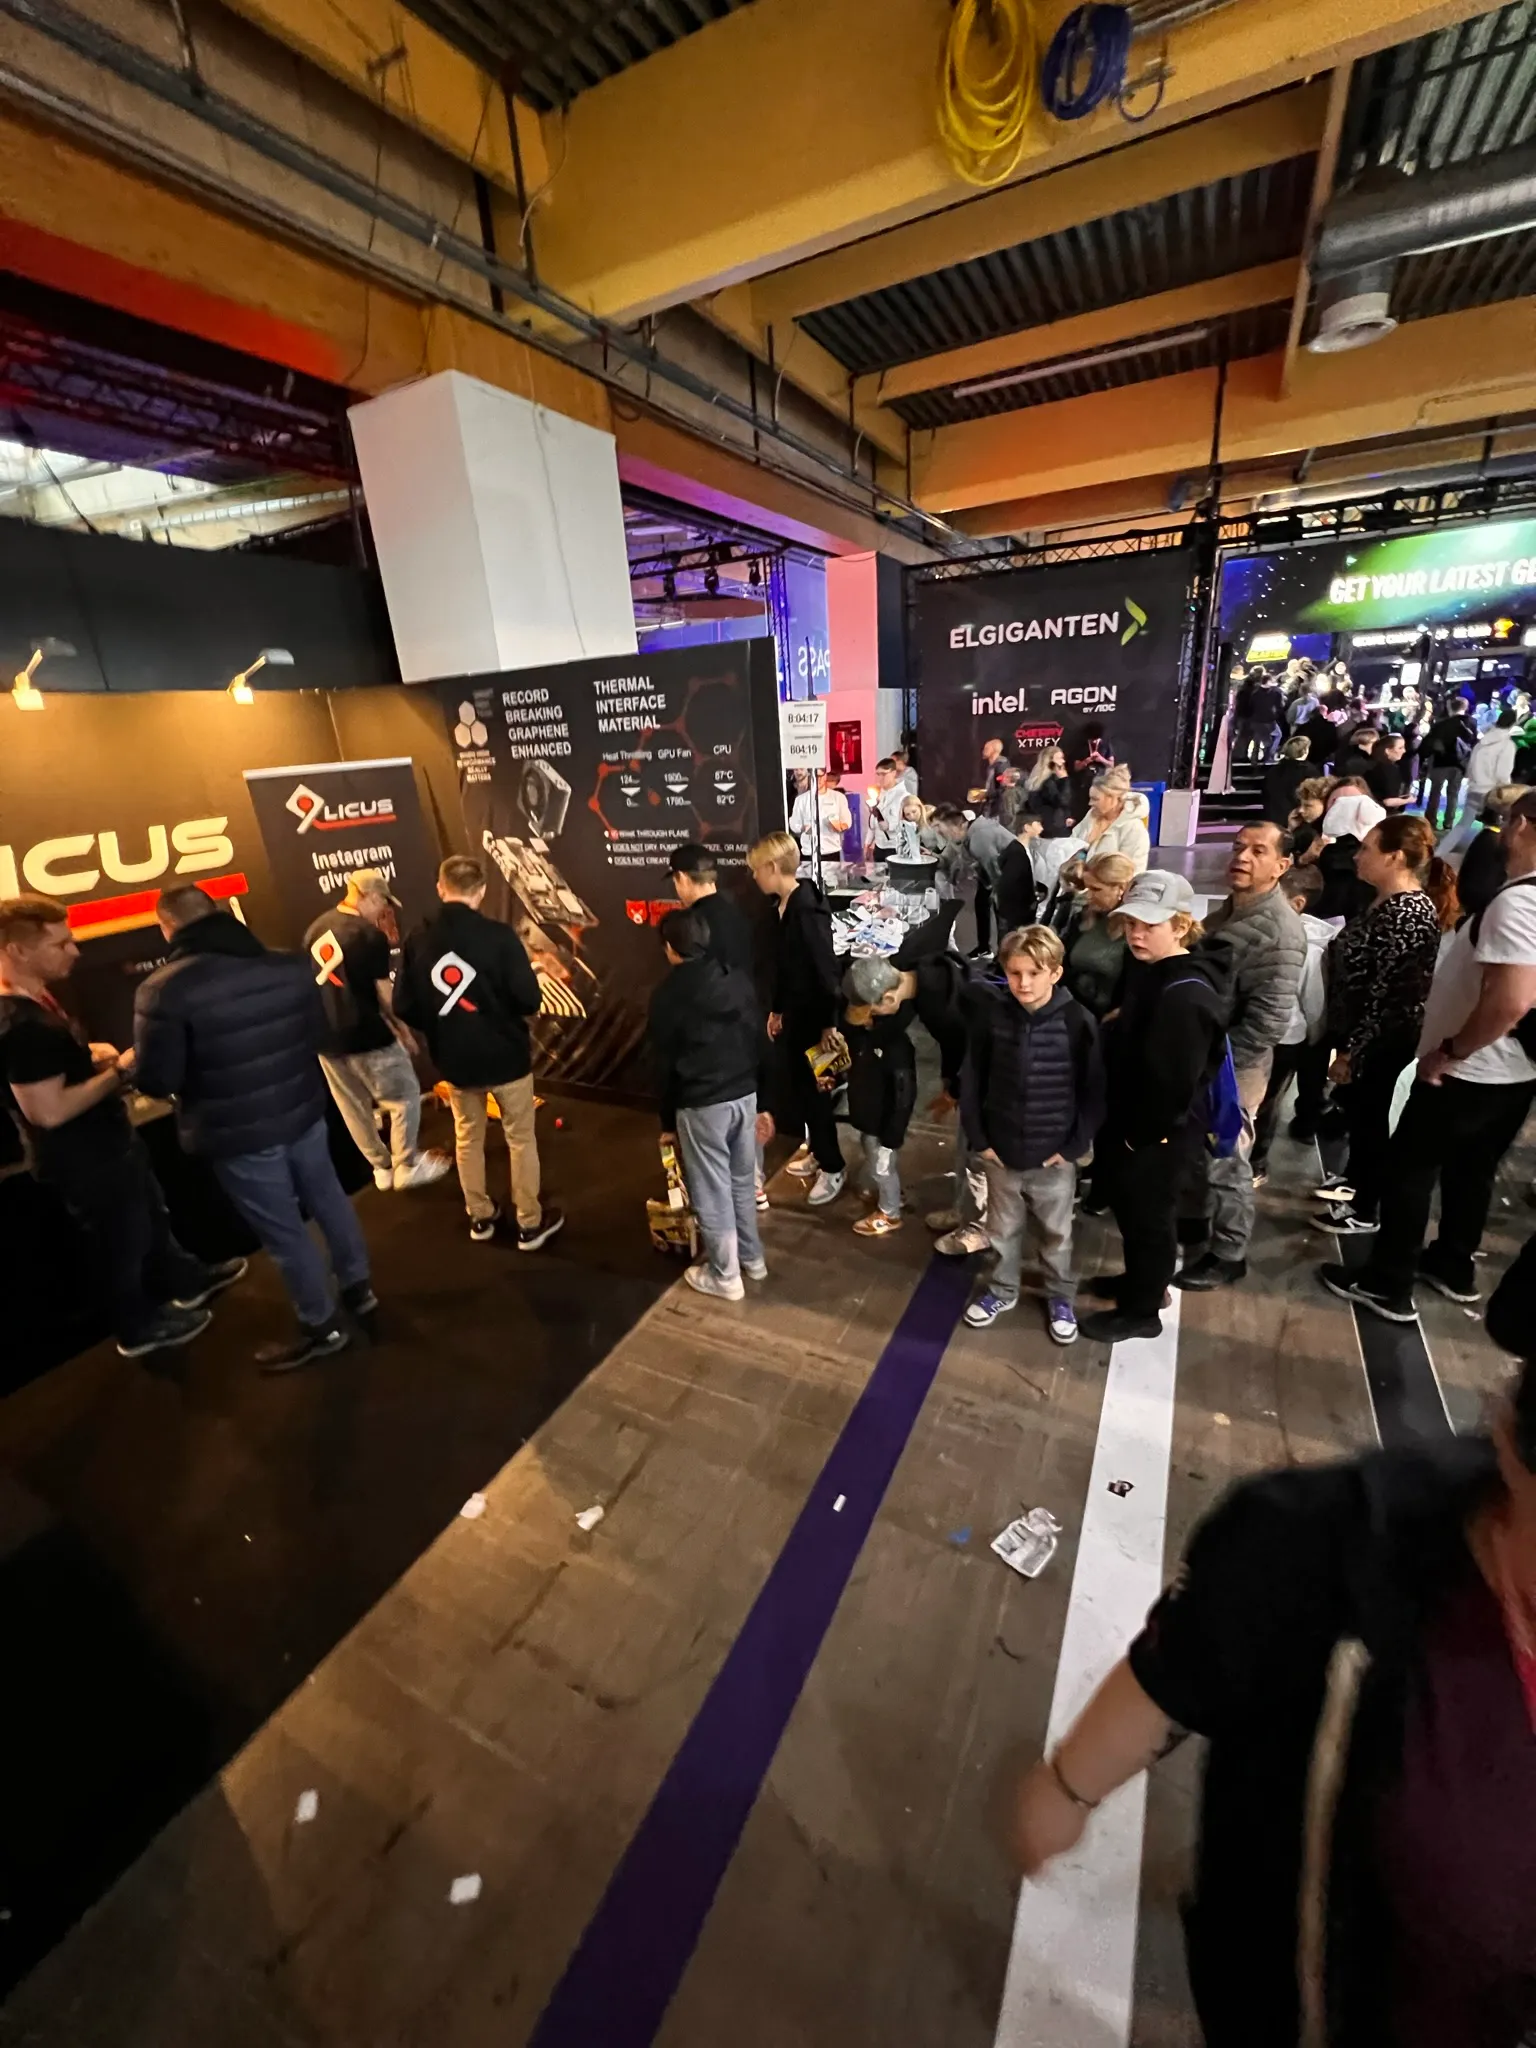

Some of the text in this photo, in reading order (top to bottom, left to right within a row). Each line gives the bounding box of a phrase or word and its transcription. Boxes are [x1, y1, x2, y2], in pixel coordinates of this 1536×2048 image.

[1329, 574, 1371, 604] GET
[1370, 569, 1426, 599] YOUR
[1428, 561, 1510, 593] LATEST
[950, 611, 1120, 649] ELGIGANTEN
[593, 675, 655, 695] THERMAL
[502, 688, 550, 707] RECORD
[595, 694, 666, 714] INTERFACE
[1051, 685, 1117, 705] AGON
[505, 705, 563, 724] BREAKING
[598, 715, 661, 733] MATERIAL
[508, 723, 569, 742] GRAPHENE
[511, 741, 572, 759] ENHANCED
[713, 745, 731, 755] CPU
[1018, 737, 1061, 748] XTRFY
[658, 748, 692, 760] GPU Fan
[312, 845, 393, 869] Instagram
